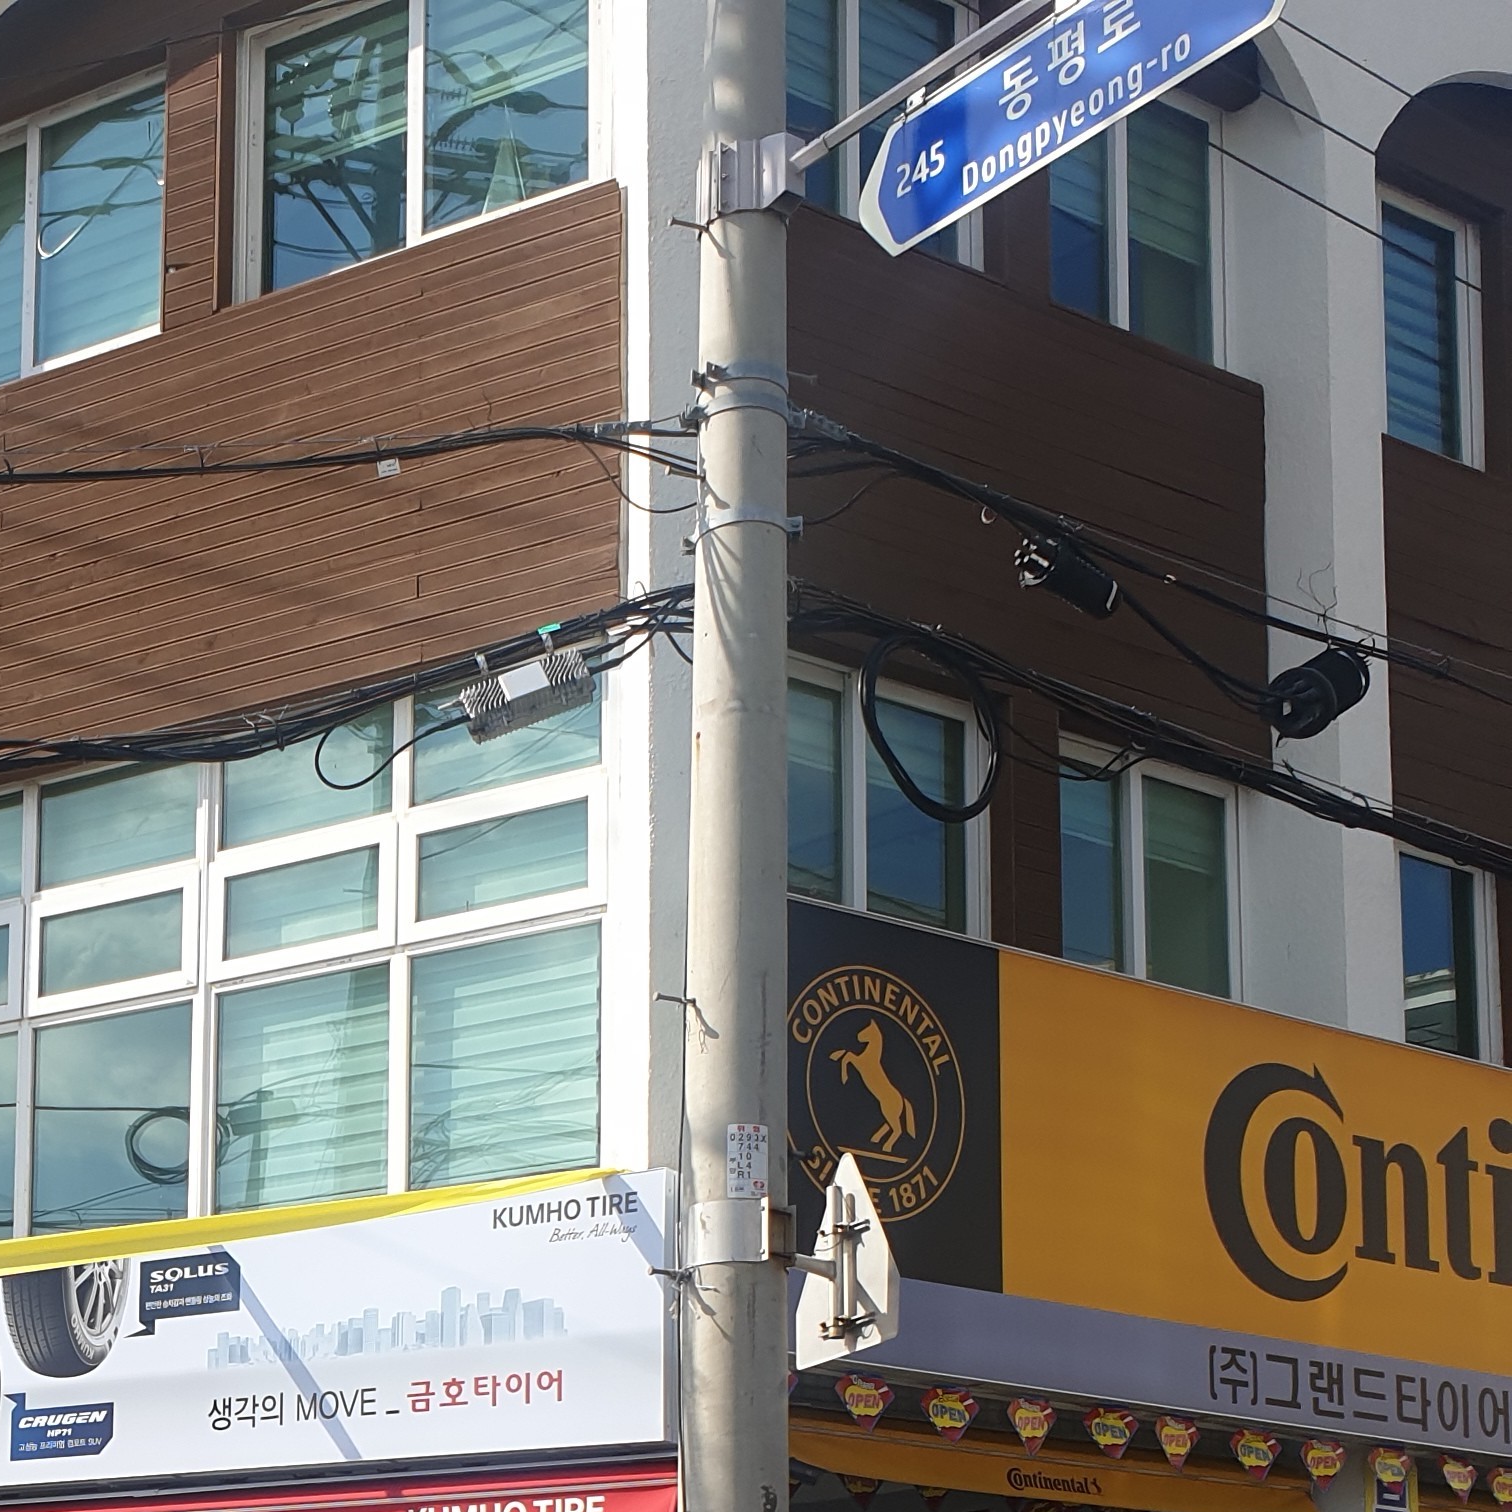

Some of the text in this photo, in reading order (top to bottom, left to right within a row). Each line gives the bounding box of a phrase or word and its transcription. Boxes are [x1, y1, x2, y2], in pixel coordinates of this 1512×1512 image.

[999, 0, 1142, 121] 동평로
[961, 32, 1192, 196] Dongpyeong-ro
[895, 140, 946, 198] 245
[791, 974, 951, 1076] CONTINENTAL
[805, 1145, 939, 1215] SIE 1871
[492, 1191, 639, 1230] KUMHO TIRE
[148, 1262, 230, 1283] SOLUS
[18, 1410, 108, 1429] CRUGEN
[207, 1392, 285, 1431] 생각의
[295, 1387, 377, 1422] MOVE
[406, 1369, 563, 1413] 금호타이어
[847, 1392, 881, 1409] OPEN
[931, 1402, 966, 1422] OPEN
[1209, 1344, 1512, 1443] (주)그랜드타이어
[1006, 1468, 1093, 1496] Continental
